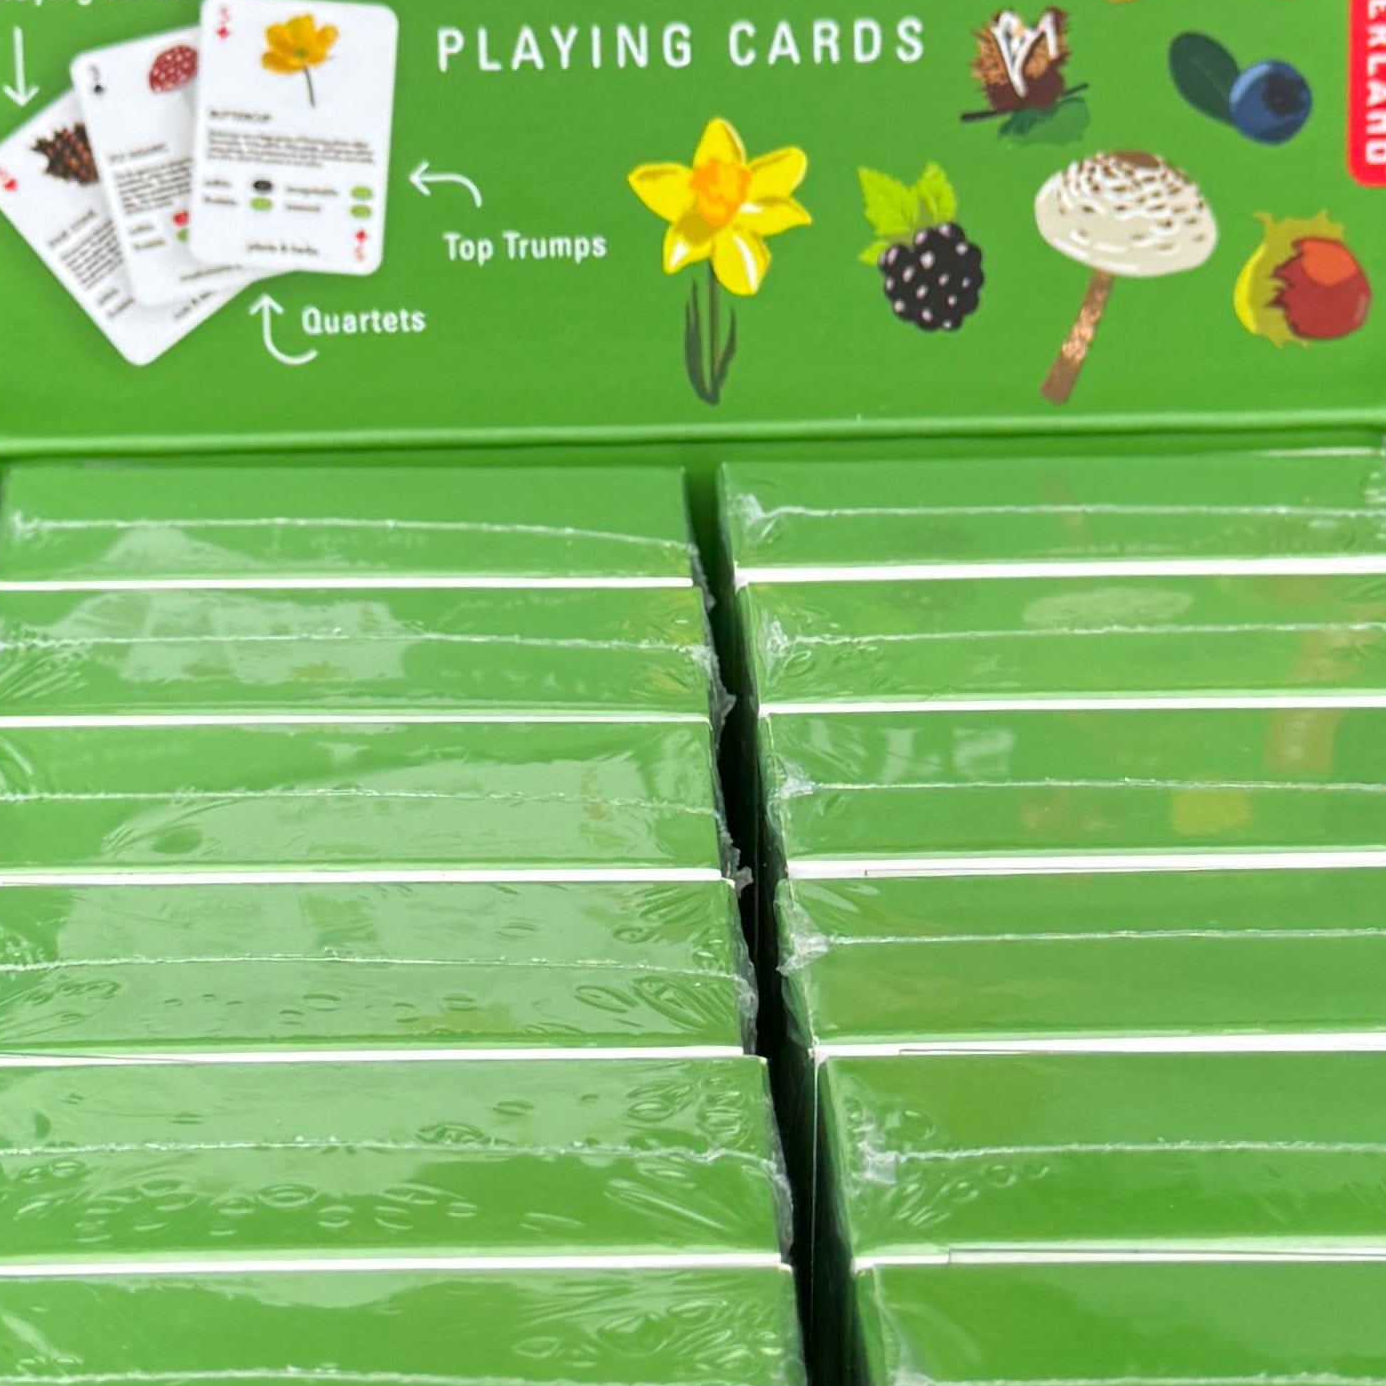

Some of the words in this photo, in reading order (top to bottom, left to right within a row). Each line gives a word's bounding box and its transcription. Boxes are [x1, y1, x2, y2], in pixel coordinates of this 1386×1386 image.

[437, 22, 691, 72] PLAYING
[729, 17, 923, 66] CARDS
[444, 232, 493, 265] Top
[503, 231, 606, 263] Trumps
[302, 306, 425, 335] Quartets
